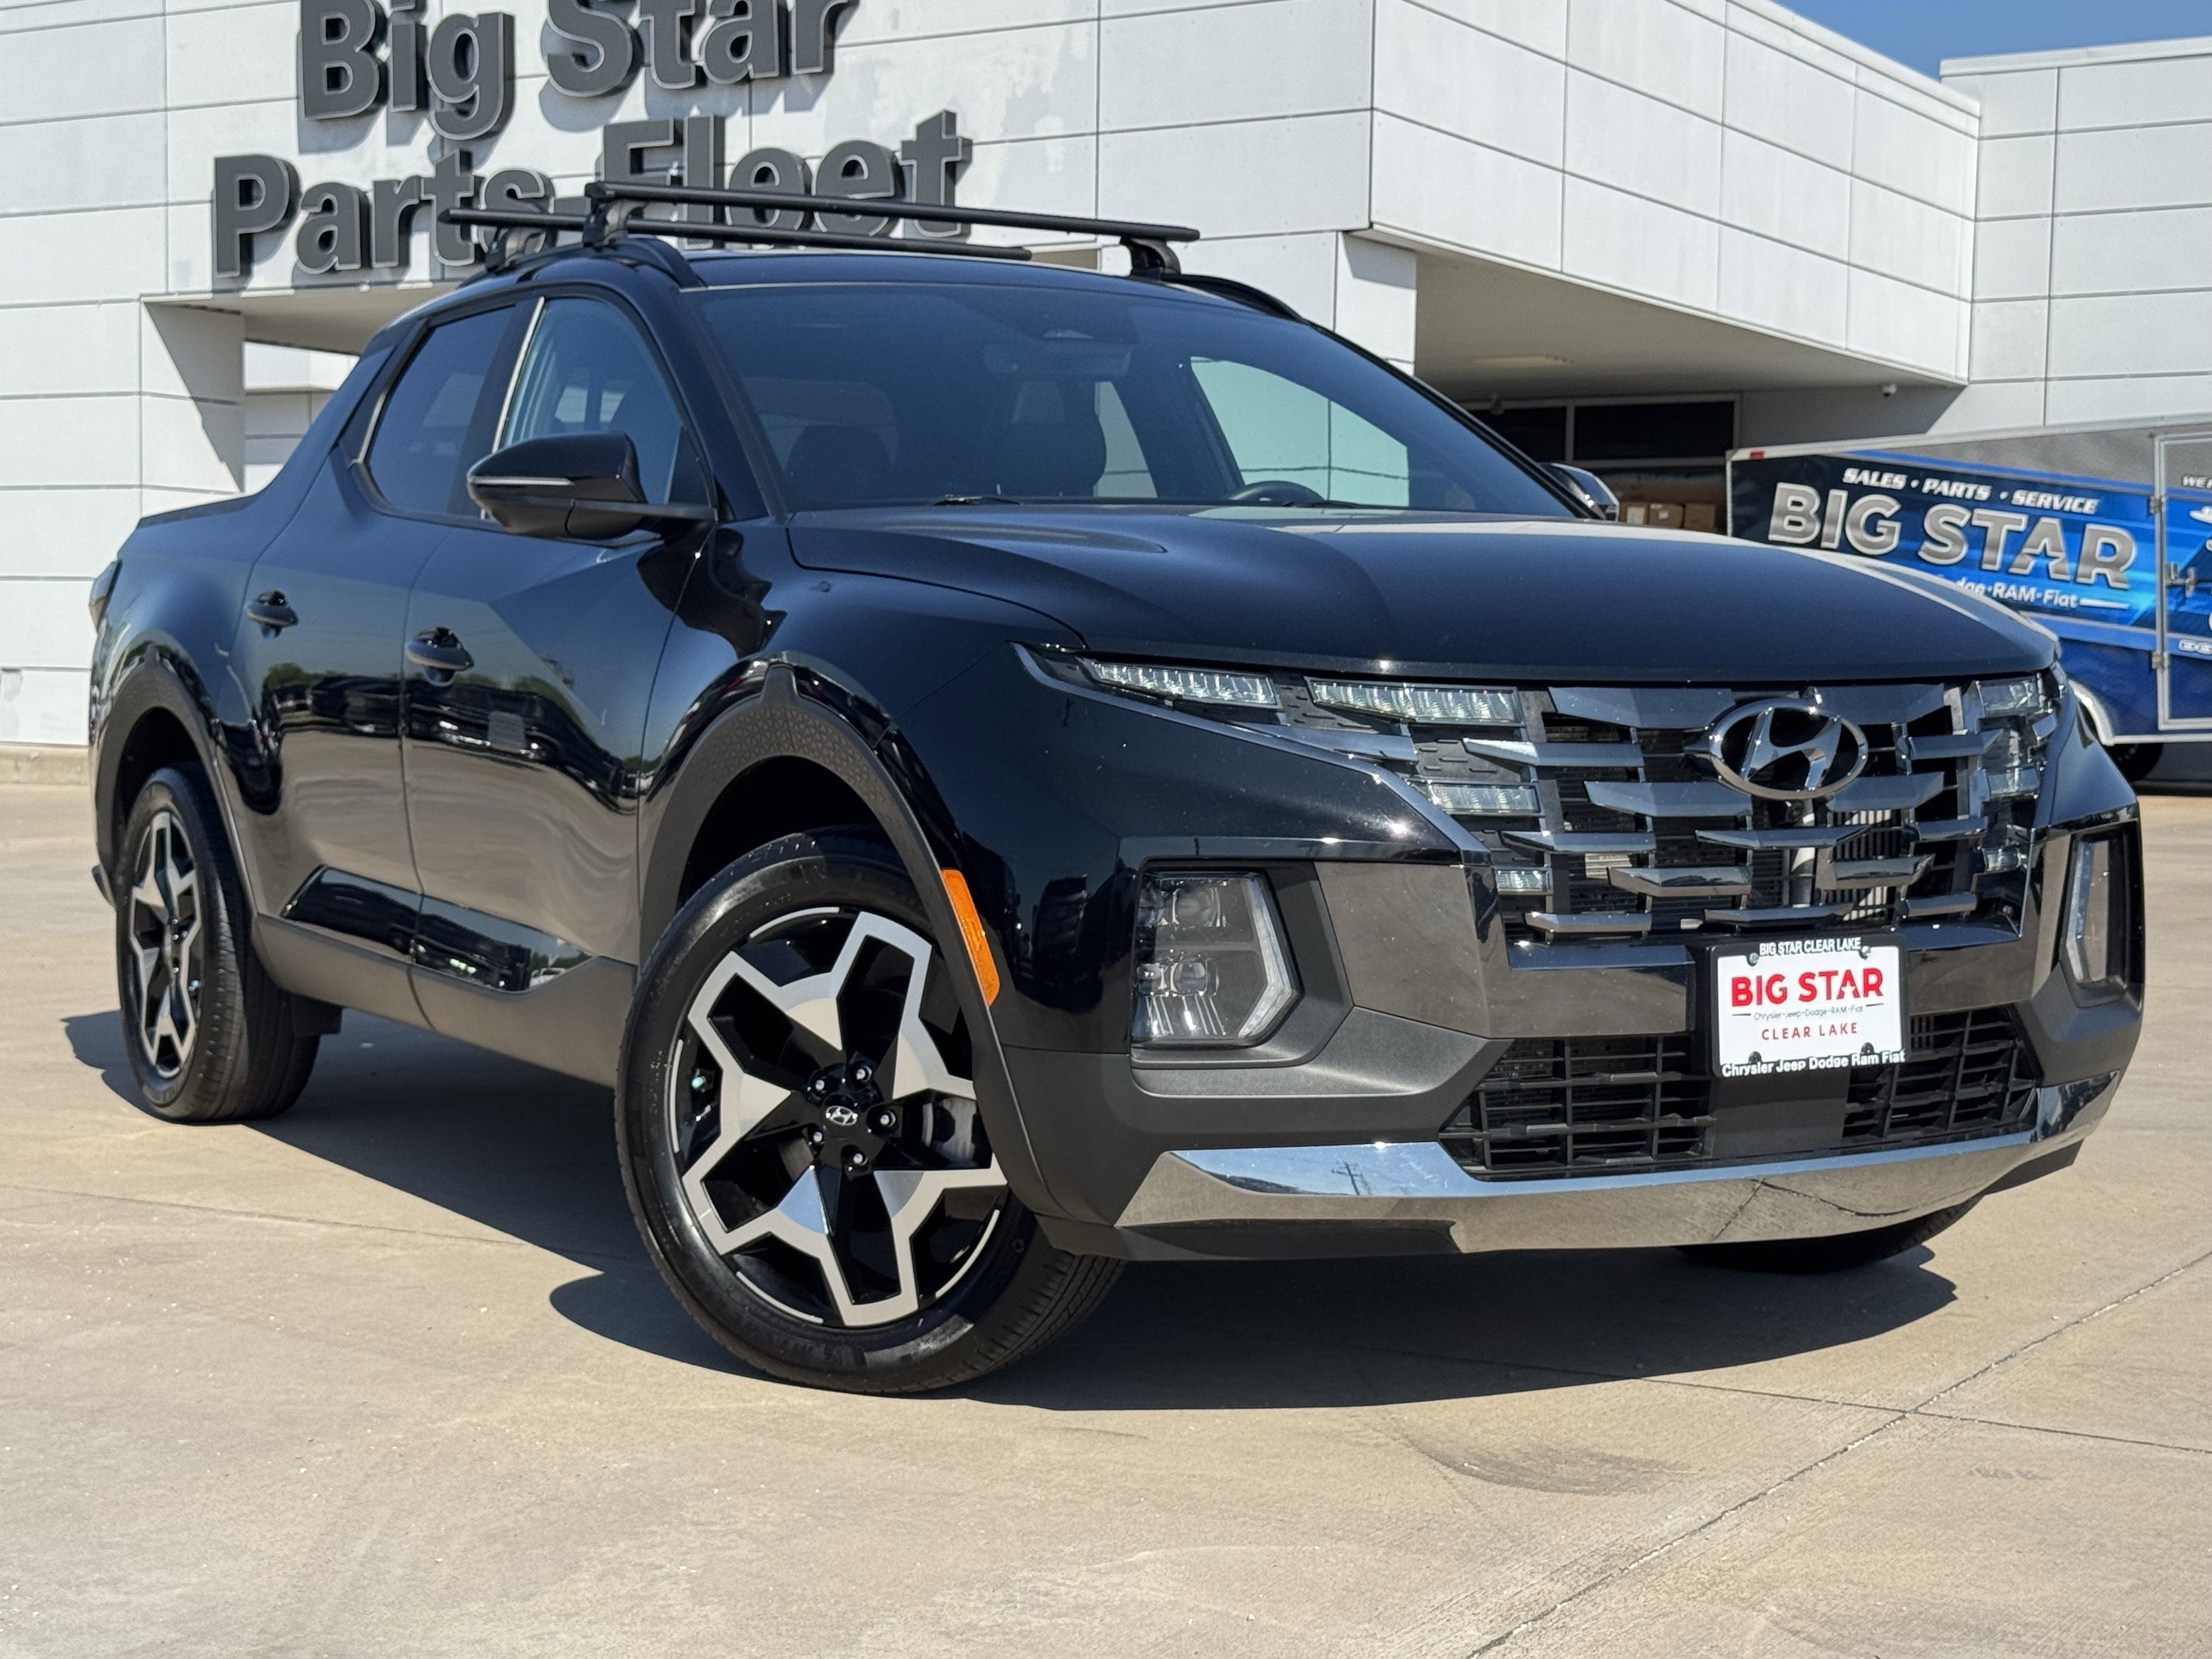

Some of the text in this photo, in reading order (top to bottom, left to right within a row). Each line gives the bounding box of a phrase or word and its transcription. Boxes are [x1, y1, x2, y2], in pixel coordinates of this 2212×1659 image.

[301, 0, 856, 140] Big Star
[1842, 467, 2101, 515] SALES PARTS SERVICE
[1768, 482, 2136, 590] BIG STAR
[1759, 937, 1861, 956] BIG STAR CLEAR LAKE
[1731, 967, 1884, 1007] BIG STAR
[1762, 1022, 1858, 1041] CLEAR LAKE
[1722, 1049, 1906, 1077] Chrysler Jeep Dodge Ram Fiat
